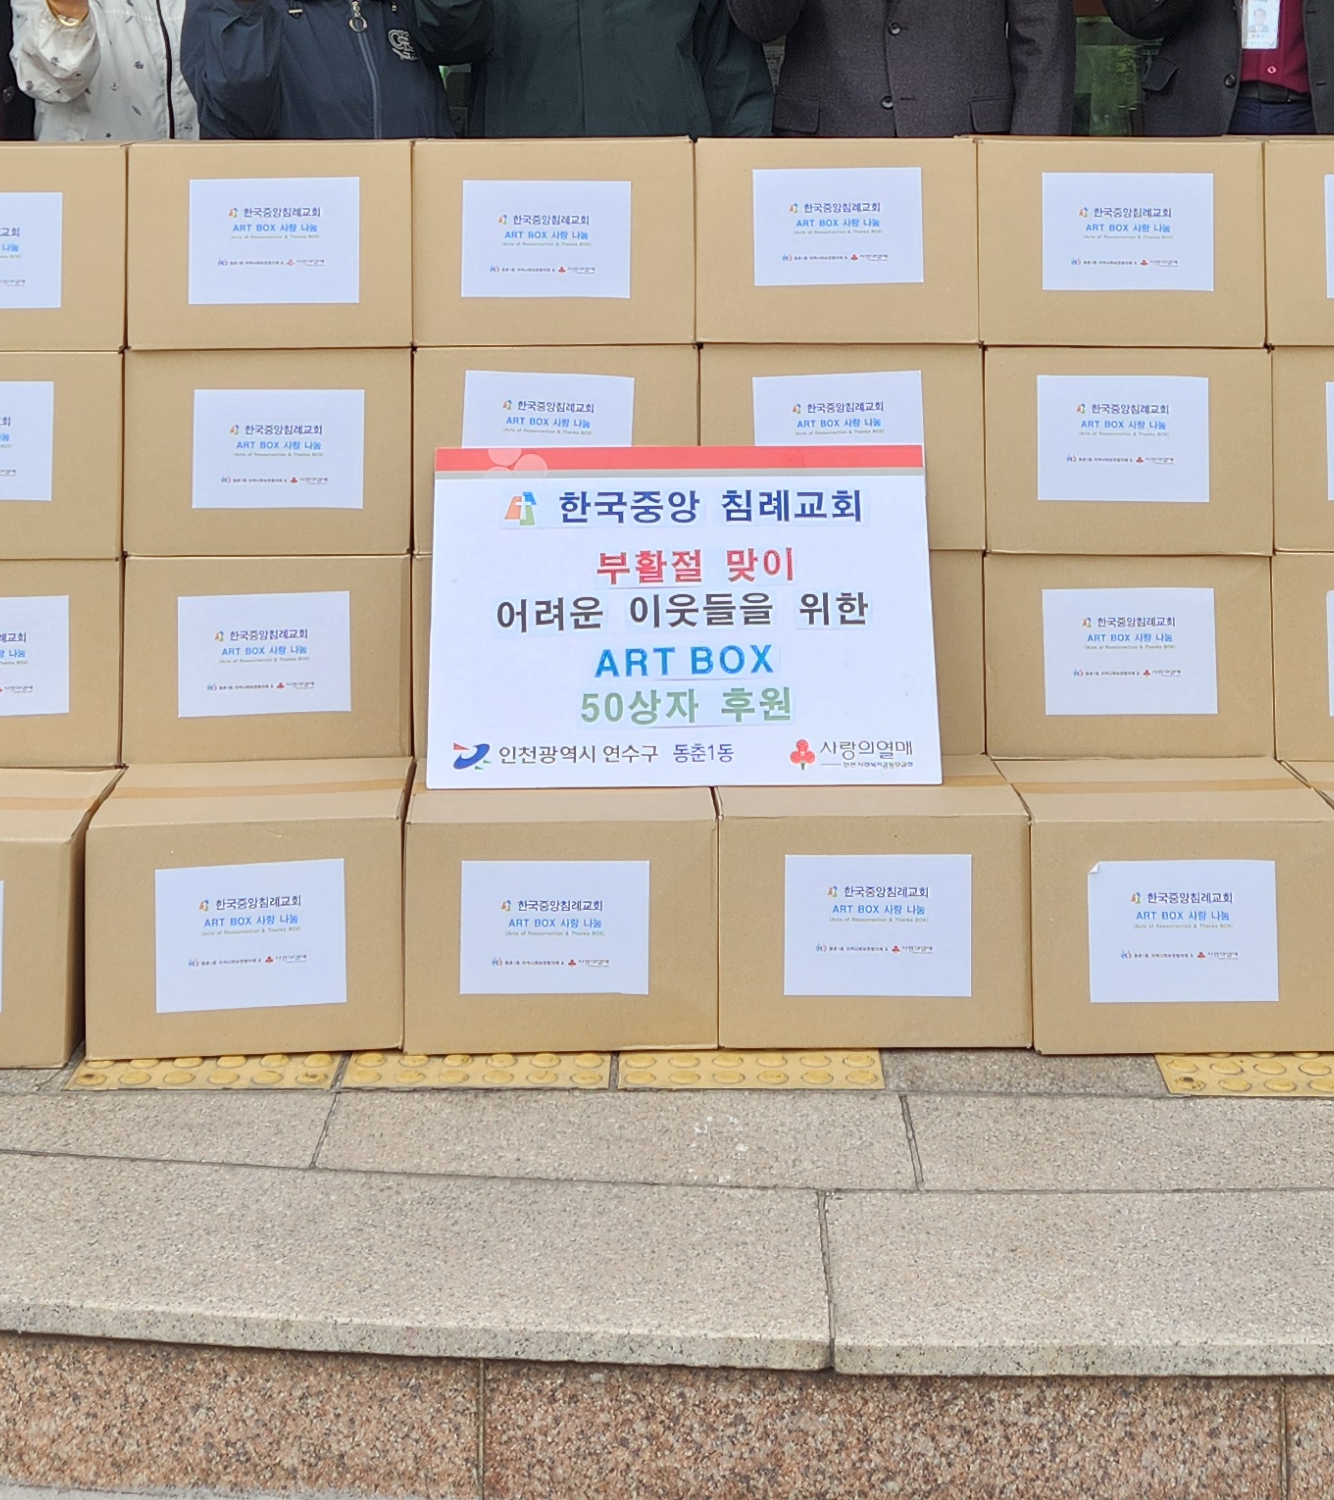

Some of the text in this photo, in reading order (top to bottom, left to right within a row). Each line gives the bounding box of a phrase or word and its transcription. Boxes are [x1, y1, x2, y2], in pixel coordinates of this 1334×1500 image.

[505, 230, 589, 241] ART BOX 사랑 나눔
[514, 214, 589, 226] 한국중앙침례교회
[559, 489, 862, 525] 한국중앙 침례교회
[596, 546, 794, 585] 부활절 맞이
[497, 591, 869, 633] 어려운 이웃들을 위한
[595, 644, 774, 678] ART BOX
[581, 686, 792, 725] 50상자 후원
[499, 743, 734, 765] 인천광역시 연수구 동춘1동
[819, 740, 913, 760] 사랑의열매
